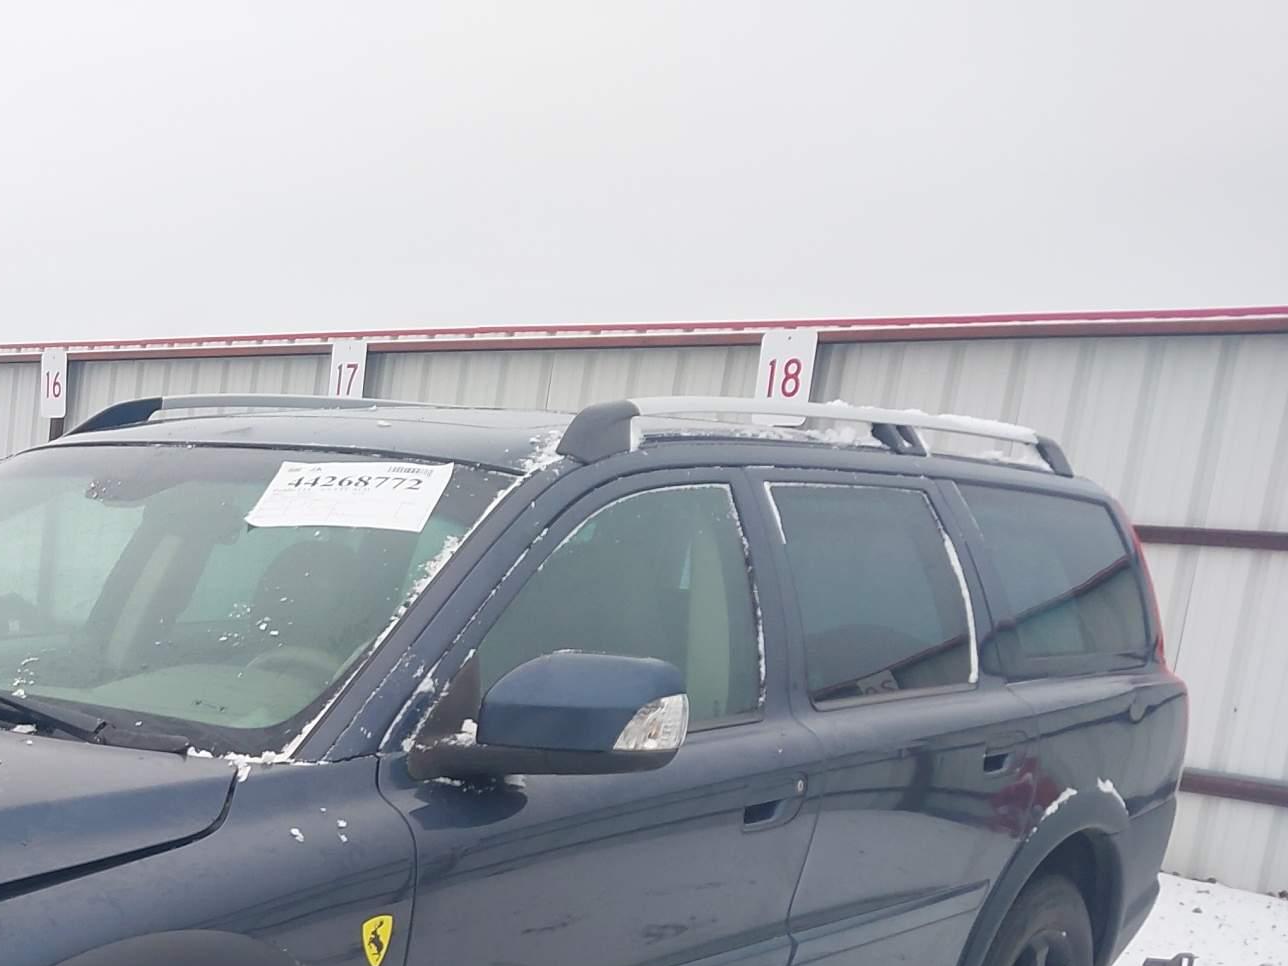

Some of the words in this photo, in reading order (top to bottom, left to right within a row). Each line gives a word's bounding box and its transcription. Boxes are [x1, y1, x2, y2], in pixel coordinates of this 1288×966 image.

[46, 370, 62, 398] 16
[336, 363, 359, 396] 17
[767, 358, 802, 398] 18
[287, 475, 424, 491] 44268772
